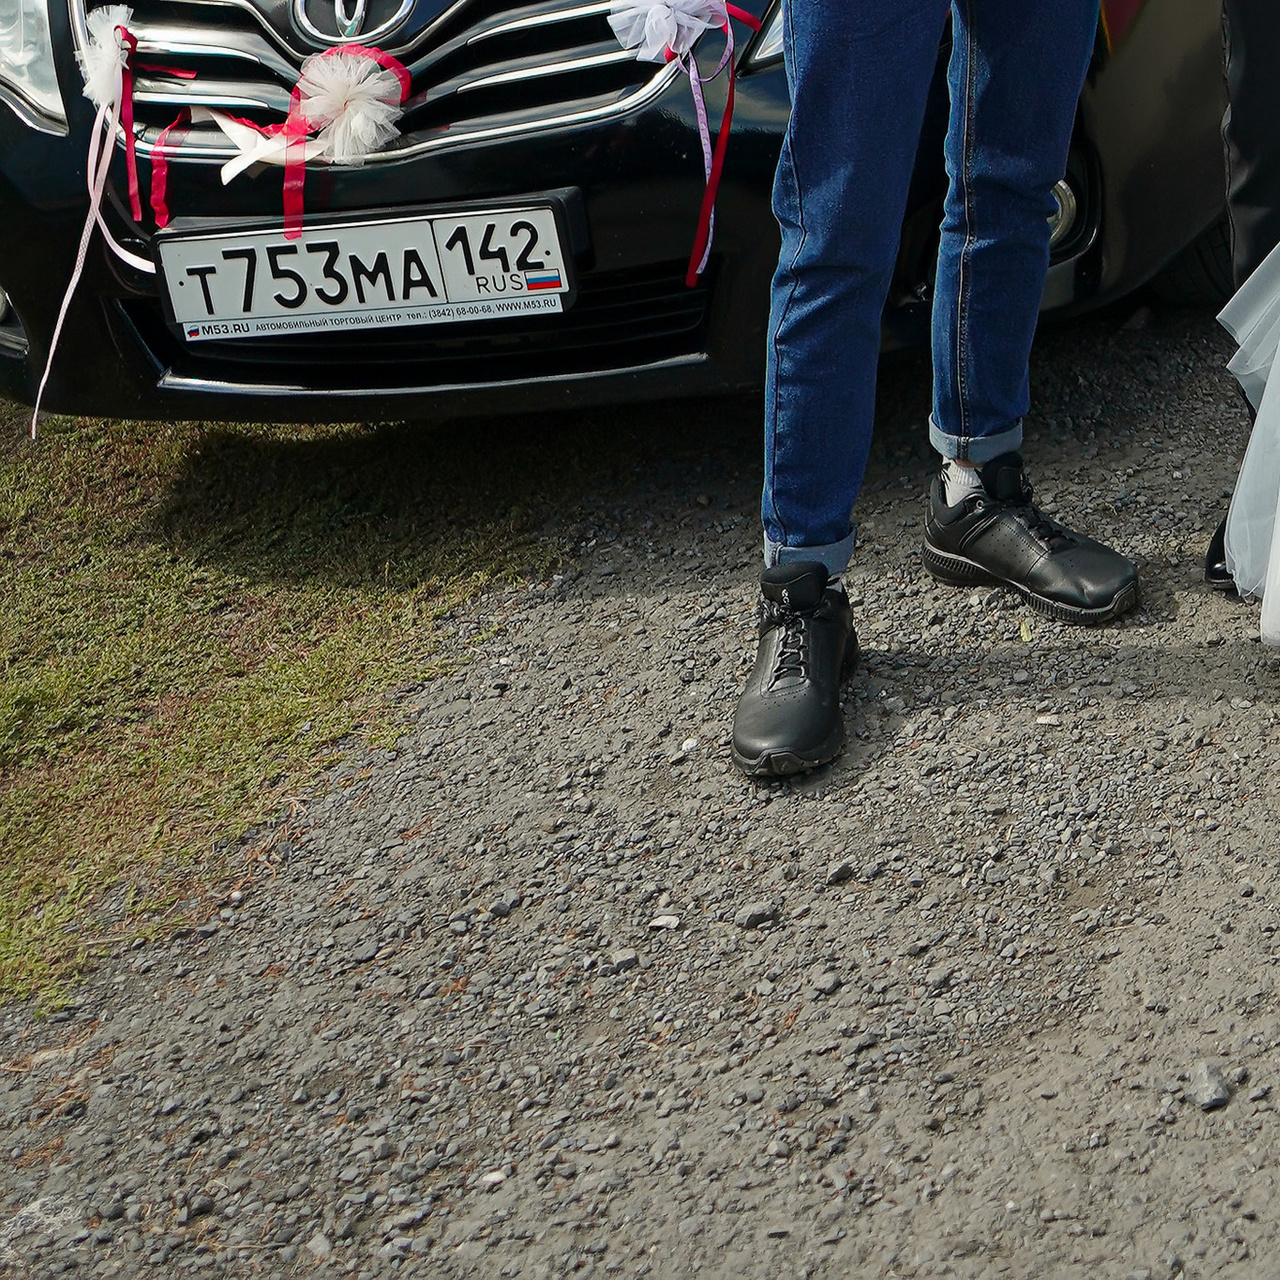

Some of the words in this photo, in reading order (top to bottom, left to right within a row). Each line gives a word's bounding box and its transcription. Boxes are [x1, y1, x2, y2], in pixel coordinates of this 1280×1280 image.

[186, 240, 438, 315] Т753МА
[445, 220, 545, 276] 142
[475, 273, 524, 294] RUS
[202, 322, 250, 336] M53.RU
[255, 317, 329, 332] АВТОМОБИЛЬНЫЙ
[330, 313, 373, 327] ТОРГОВЫЙ
[374, 313, 402, 324] ЦЕНТР
[428, 307, 455, 320] (3842)
[495, 298, 557, 312] WWW.M53.RU
